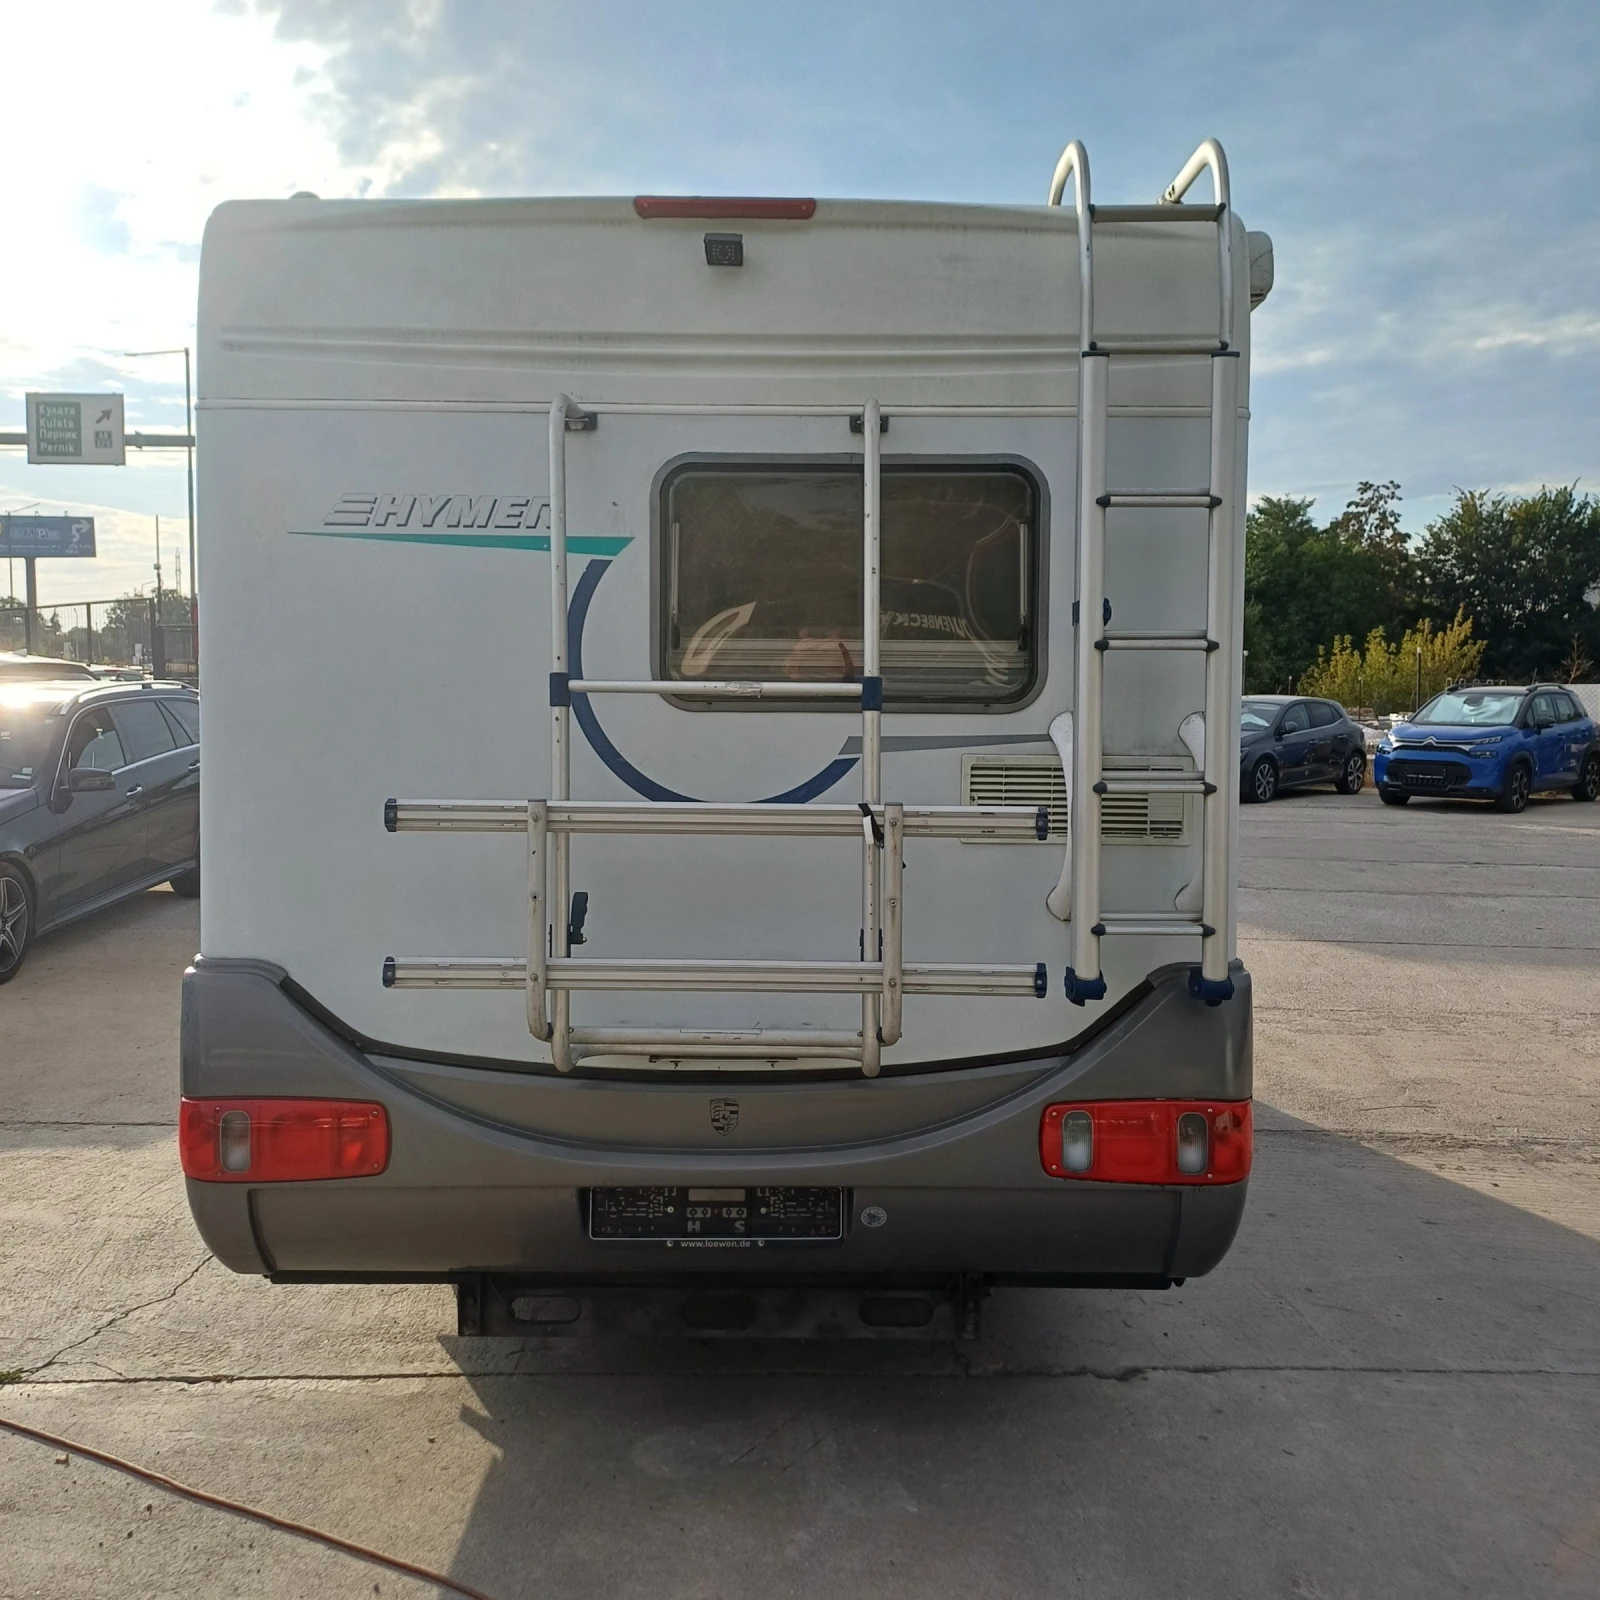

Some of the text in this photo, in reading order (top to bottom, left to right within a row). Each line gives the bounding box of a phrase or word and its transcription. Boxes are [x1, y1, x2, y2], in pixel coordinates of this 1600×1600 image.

[39, 403, 76, 416] Кулата
[39, 418, 75, 428] Kulata
[39, 428, 78, 441] Перник
[40, 441, 76, 453] Pernik
[680, 1239, 751, 1248] www.loewen.de
